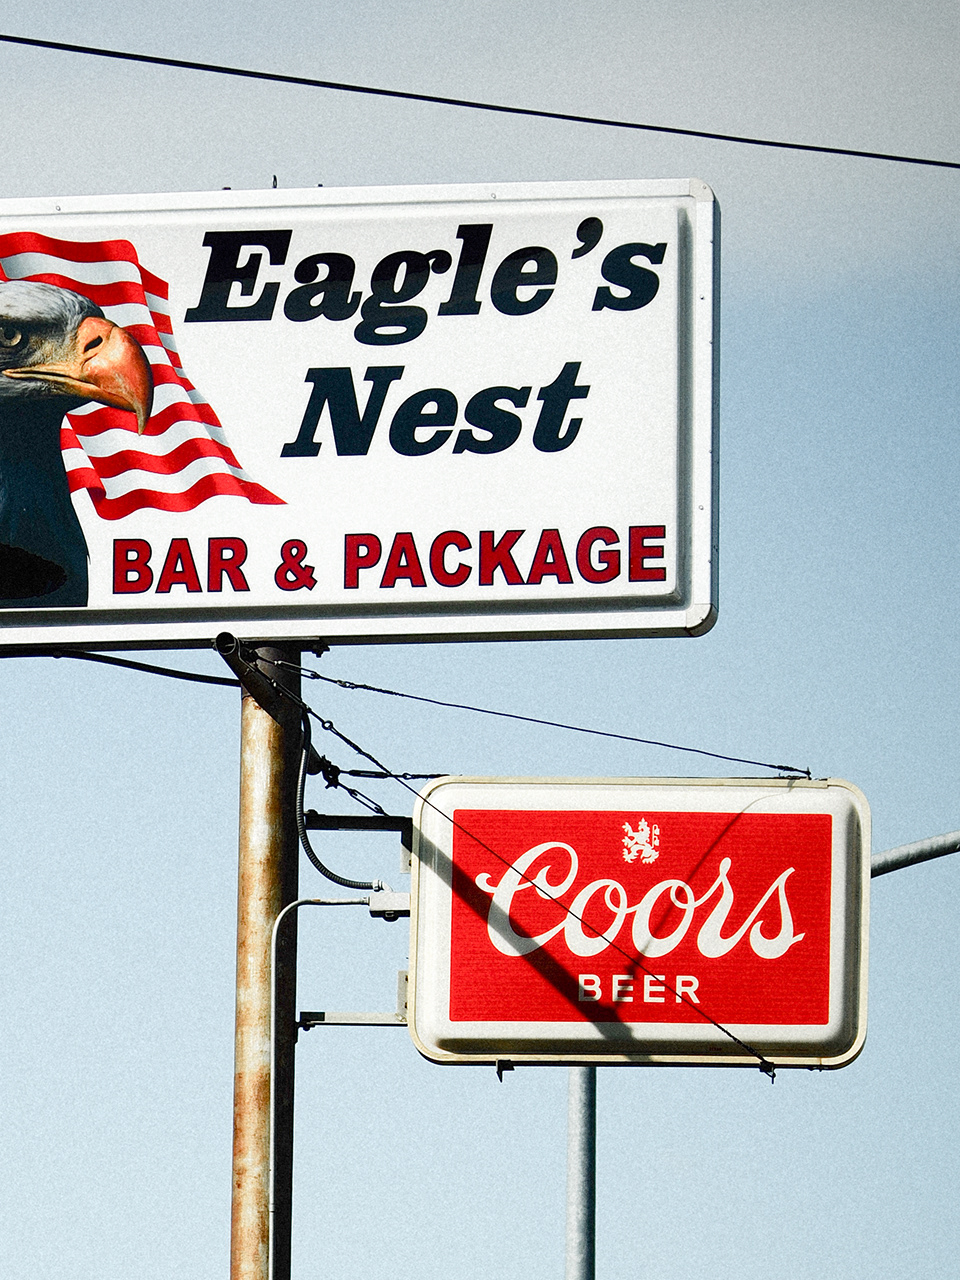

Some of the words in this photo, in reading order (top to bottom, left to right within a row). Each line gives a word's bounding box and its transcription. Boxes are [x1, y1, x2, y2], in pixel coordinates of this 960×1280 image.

[184, 216, 668, 345] Eagle's
[280, 361, 590, 457] Nest
[112, 537, 250, 594] BAR
[274, 538, 317, 592] &
[343, 525, 668, 590] PACKAGE
[475, 841, 806, 959] Coors
[578, 974, 700, 1004] BEER
